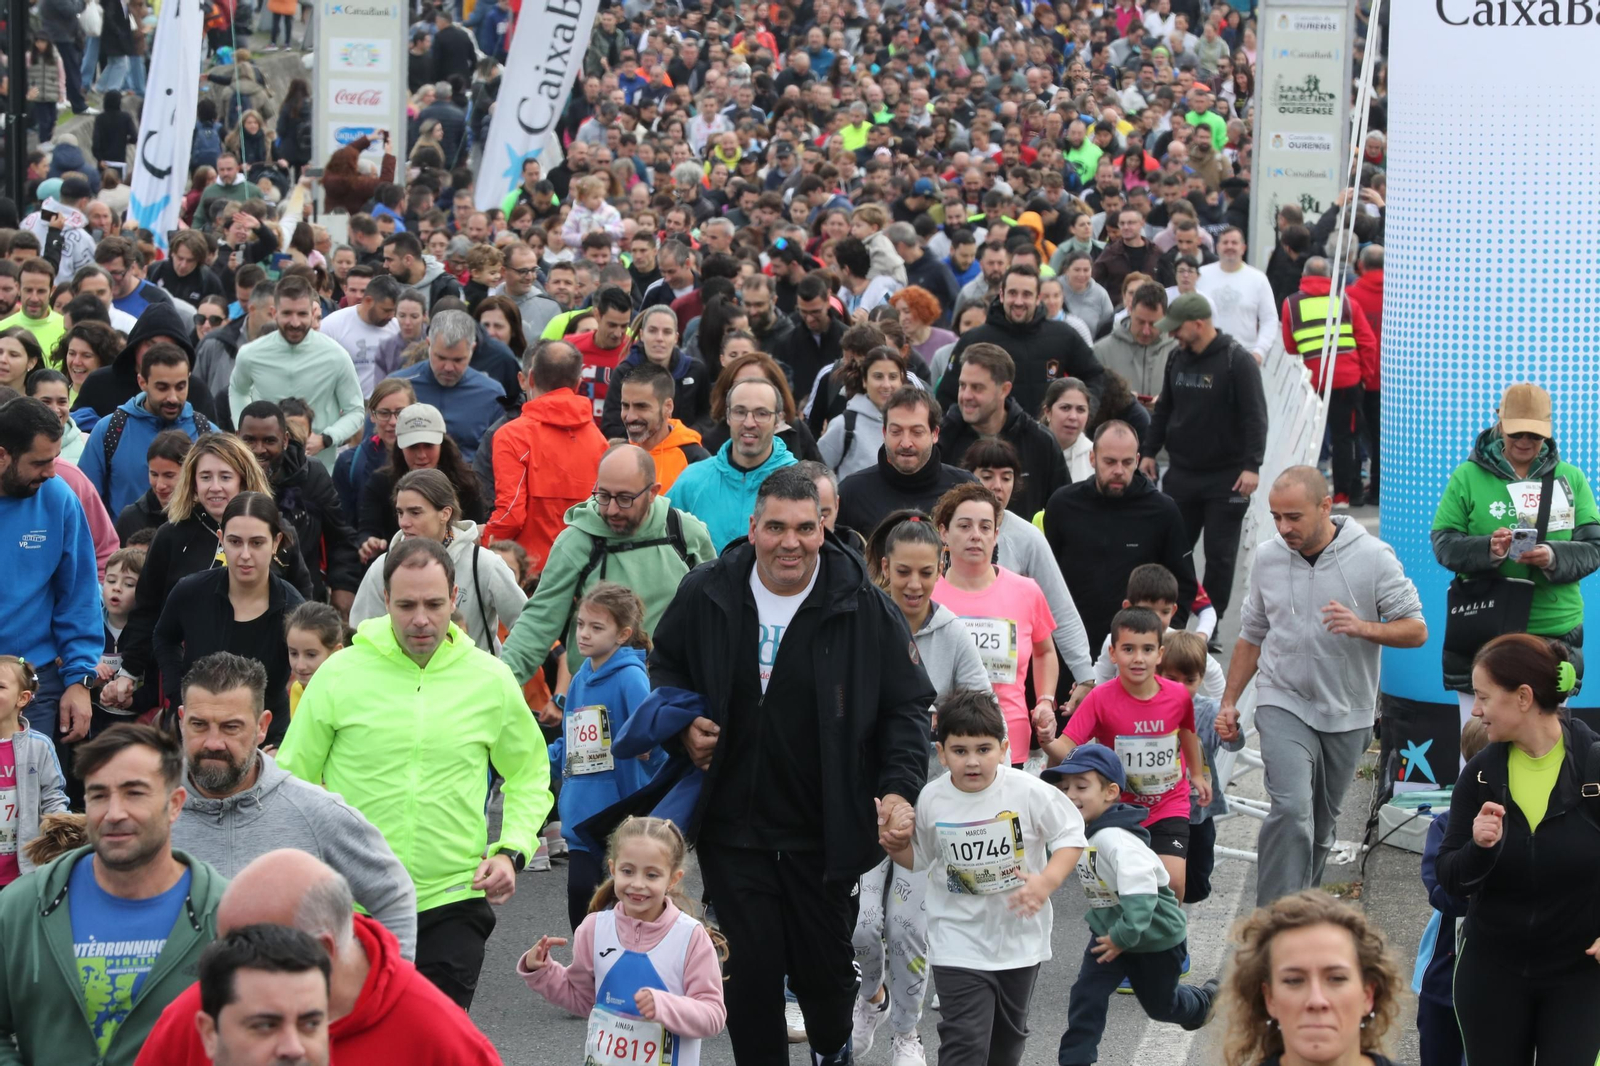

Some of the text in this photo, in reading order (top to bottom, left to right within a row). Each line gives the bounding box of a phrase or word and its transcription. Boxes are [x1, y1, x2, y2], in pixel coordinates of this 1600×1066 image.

[344, 5, 390, 16] CaixaBank
[1436, 0, 1600, 26] CaixaB
[1294, 22, 1337, 30] OURENSE
[1278, 106, 1334, 115] OURENSE
[1288, 141, 1331, 150] OURENSE
[1451, 600, 1495, 614] GAELLE
[992, 662, 1011, 671] XLVIII
[1134, 719, 1165, 734] XLVI
[1126, 748, 1174, 768] 11389
[965, 828, 987, 837] MARCOS
[950, 836, 1011, 861] 10746
[615, 1021, 634, 1032] AINARA
[597, 1029, 657, 1064] 11819
